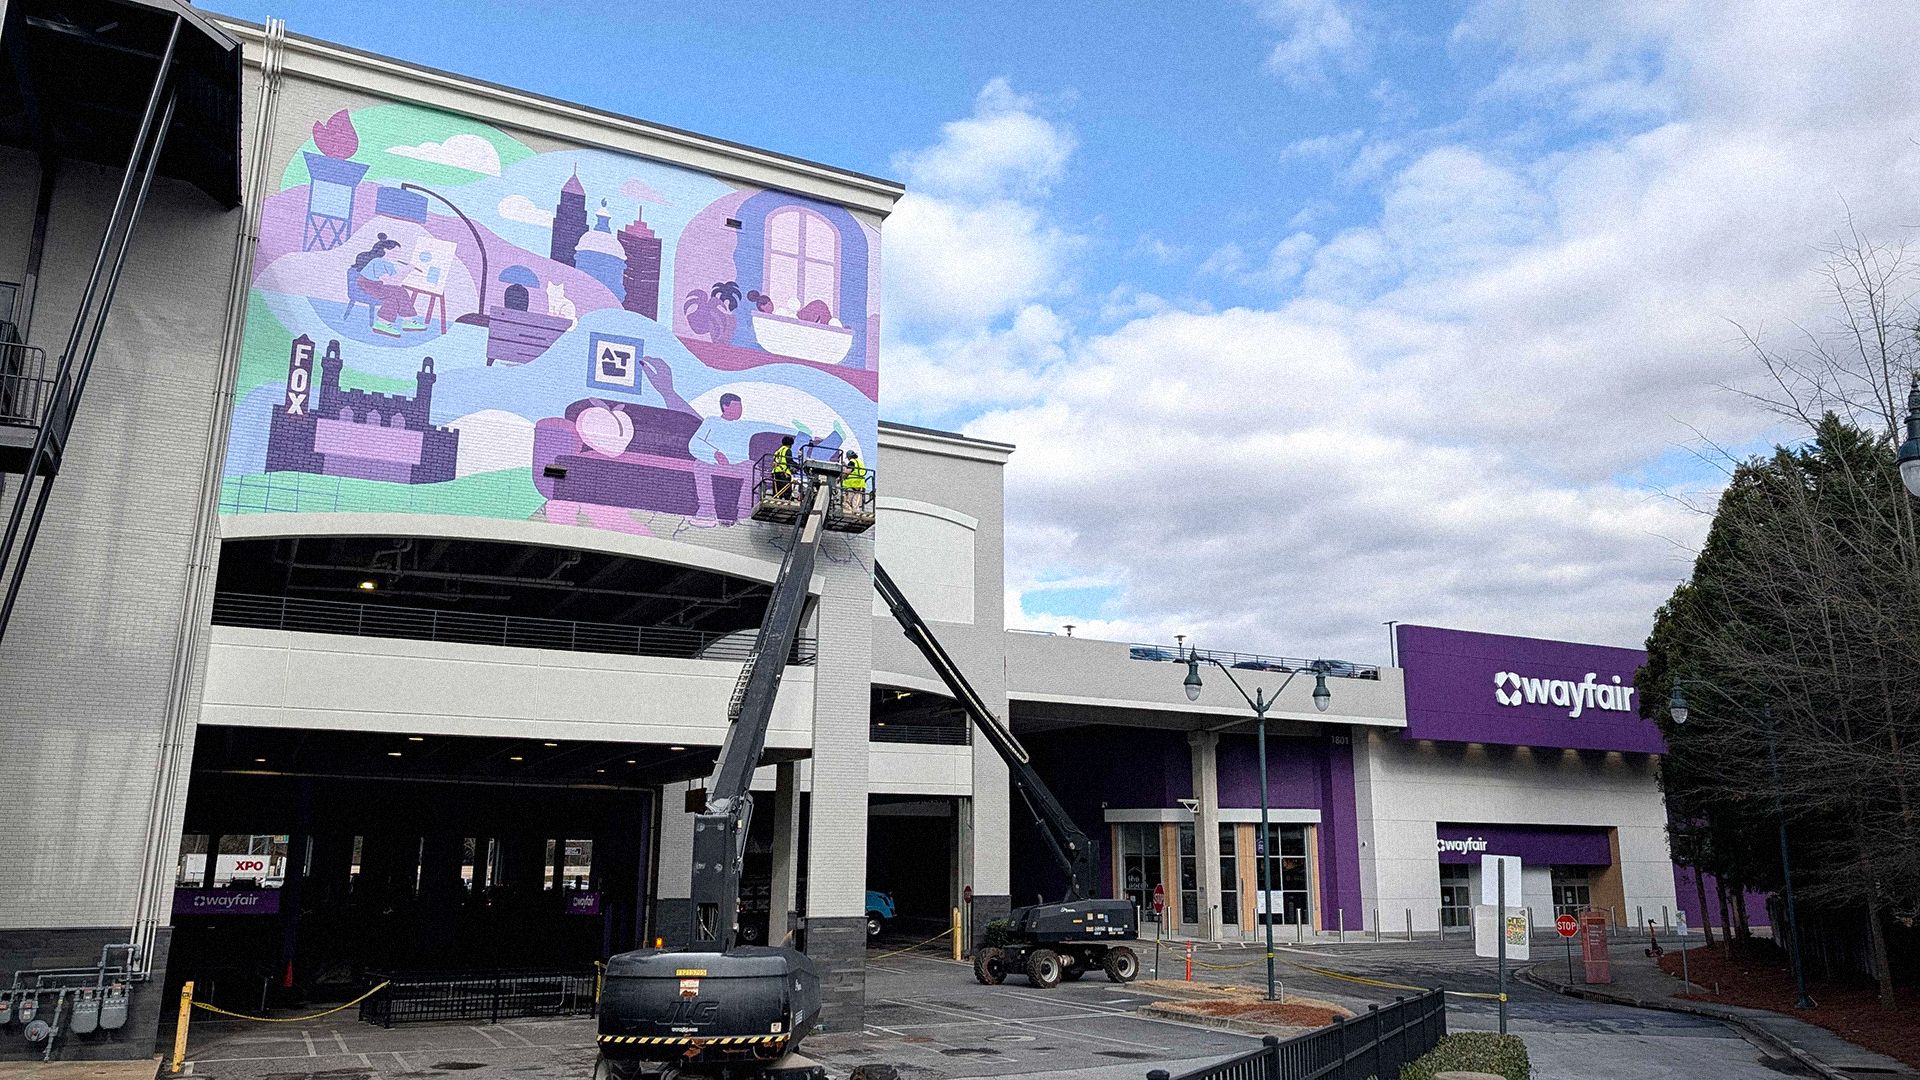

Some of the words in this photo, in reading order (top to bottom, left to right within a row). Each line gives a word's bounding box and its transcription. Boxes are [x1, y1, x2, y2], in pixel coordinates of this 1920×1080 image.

[287, 344, 312, 415] FOX
[1520, 672, 1635, 718] wayfair
[1331, 735, 1349, 745] 1801
[1444, 836, 1488, 855] wayfair
[235, 861, 264, 871] XPO
[206, 893, 259, 908] wayfair
[1557, 921, 1577, 932] STOP
[655, 1001, 720, 1026] JLG
